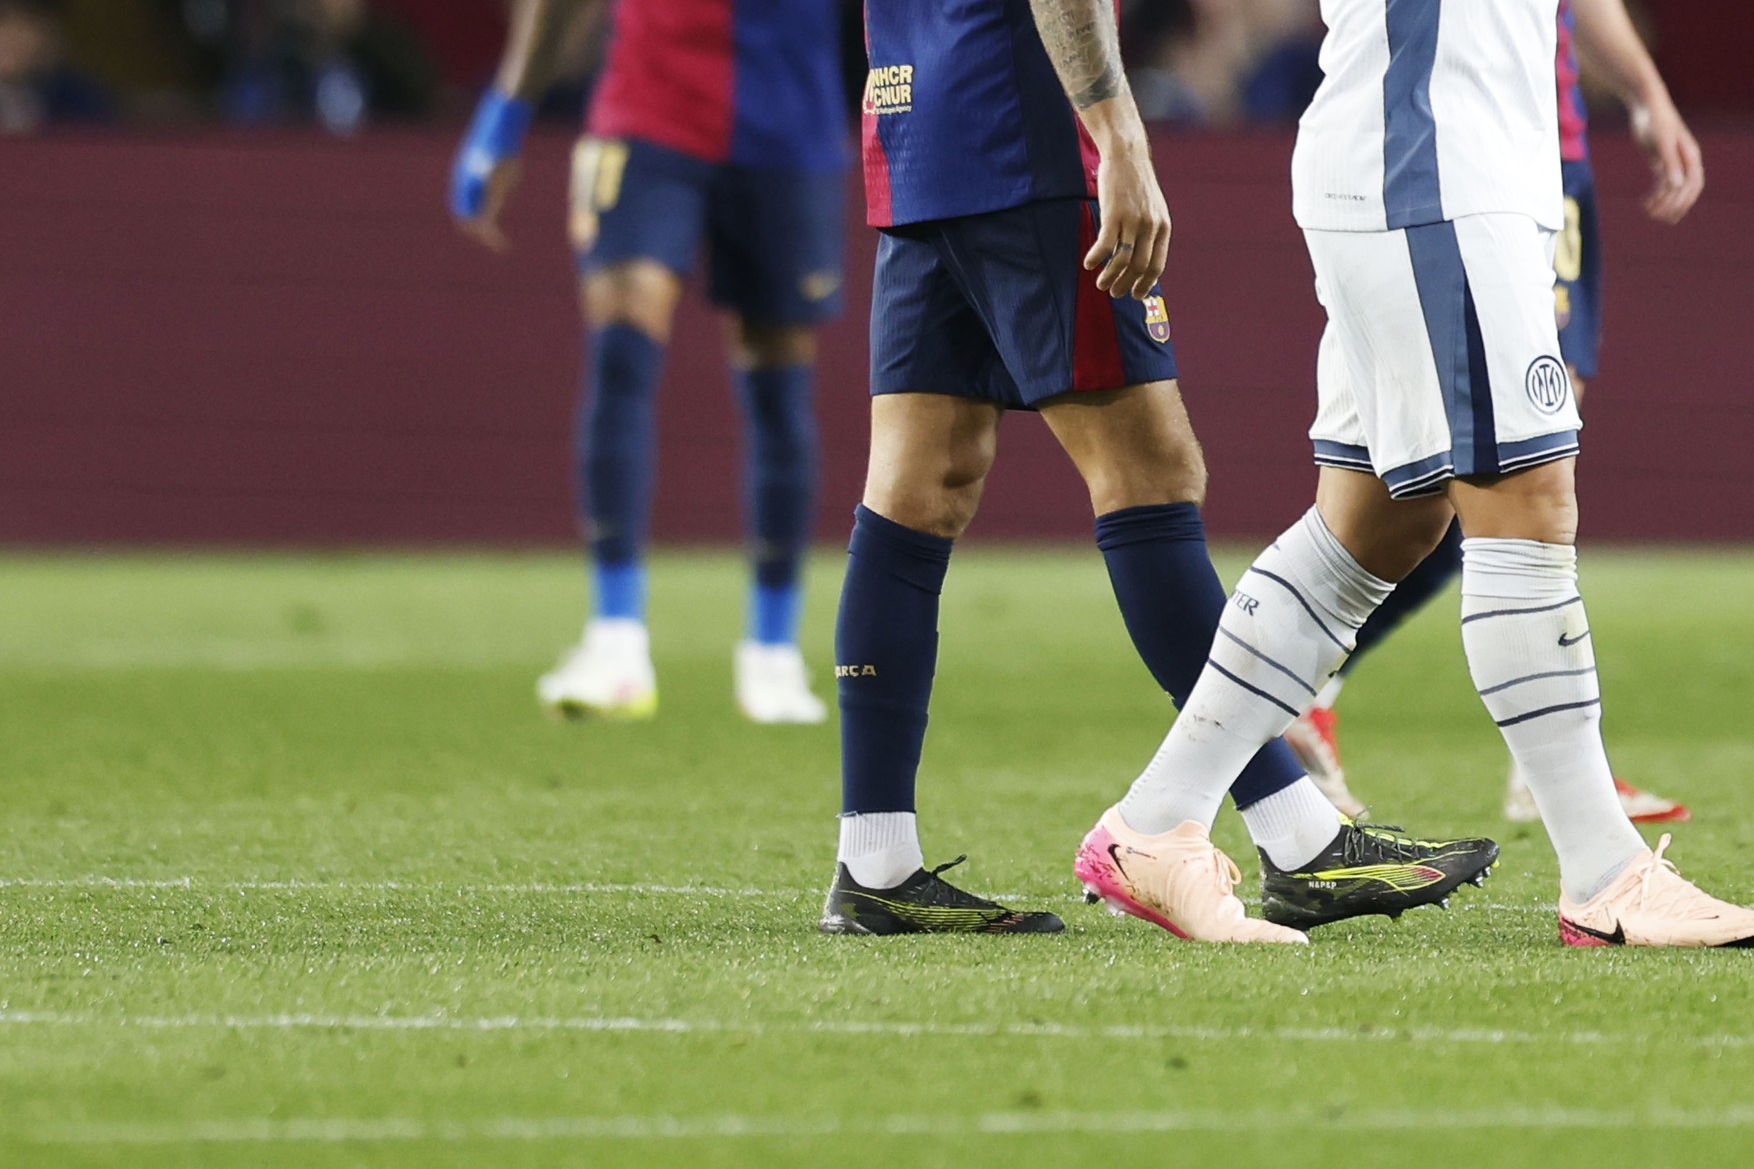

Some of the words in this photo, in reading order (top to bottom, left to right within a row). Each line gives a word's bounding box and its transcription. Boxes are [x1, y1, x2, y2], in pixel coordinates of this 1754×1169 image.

[869, 64, 914, 87] NHCR
[873, 84, 912, 107] CNUR
[1232, 590, 1260, 617] TER
[835, 664, 877, 679] ARÇA
